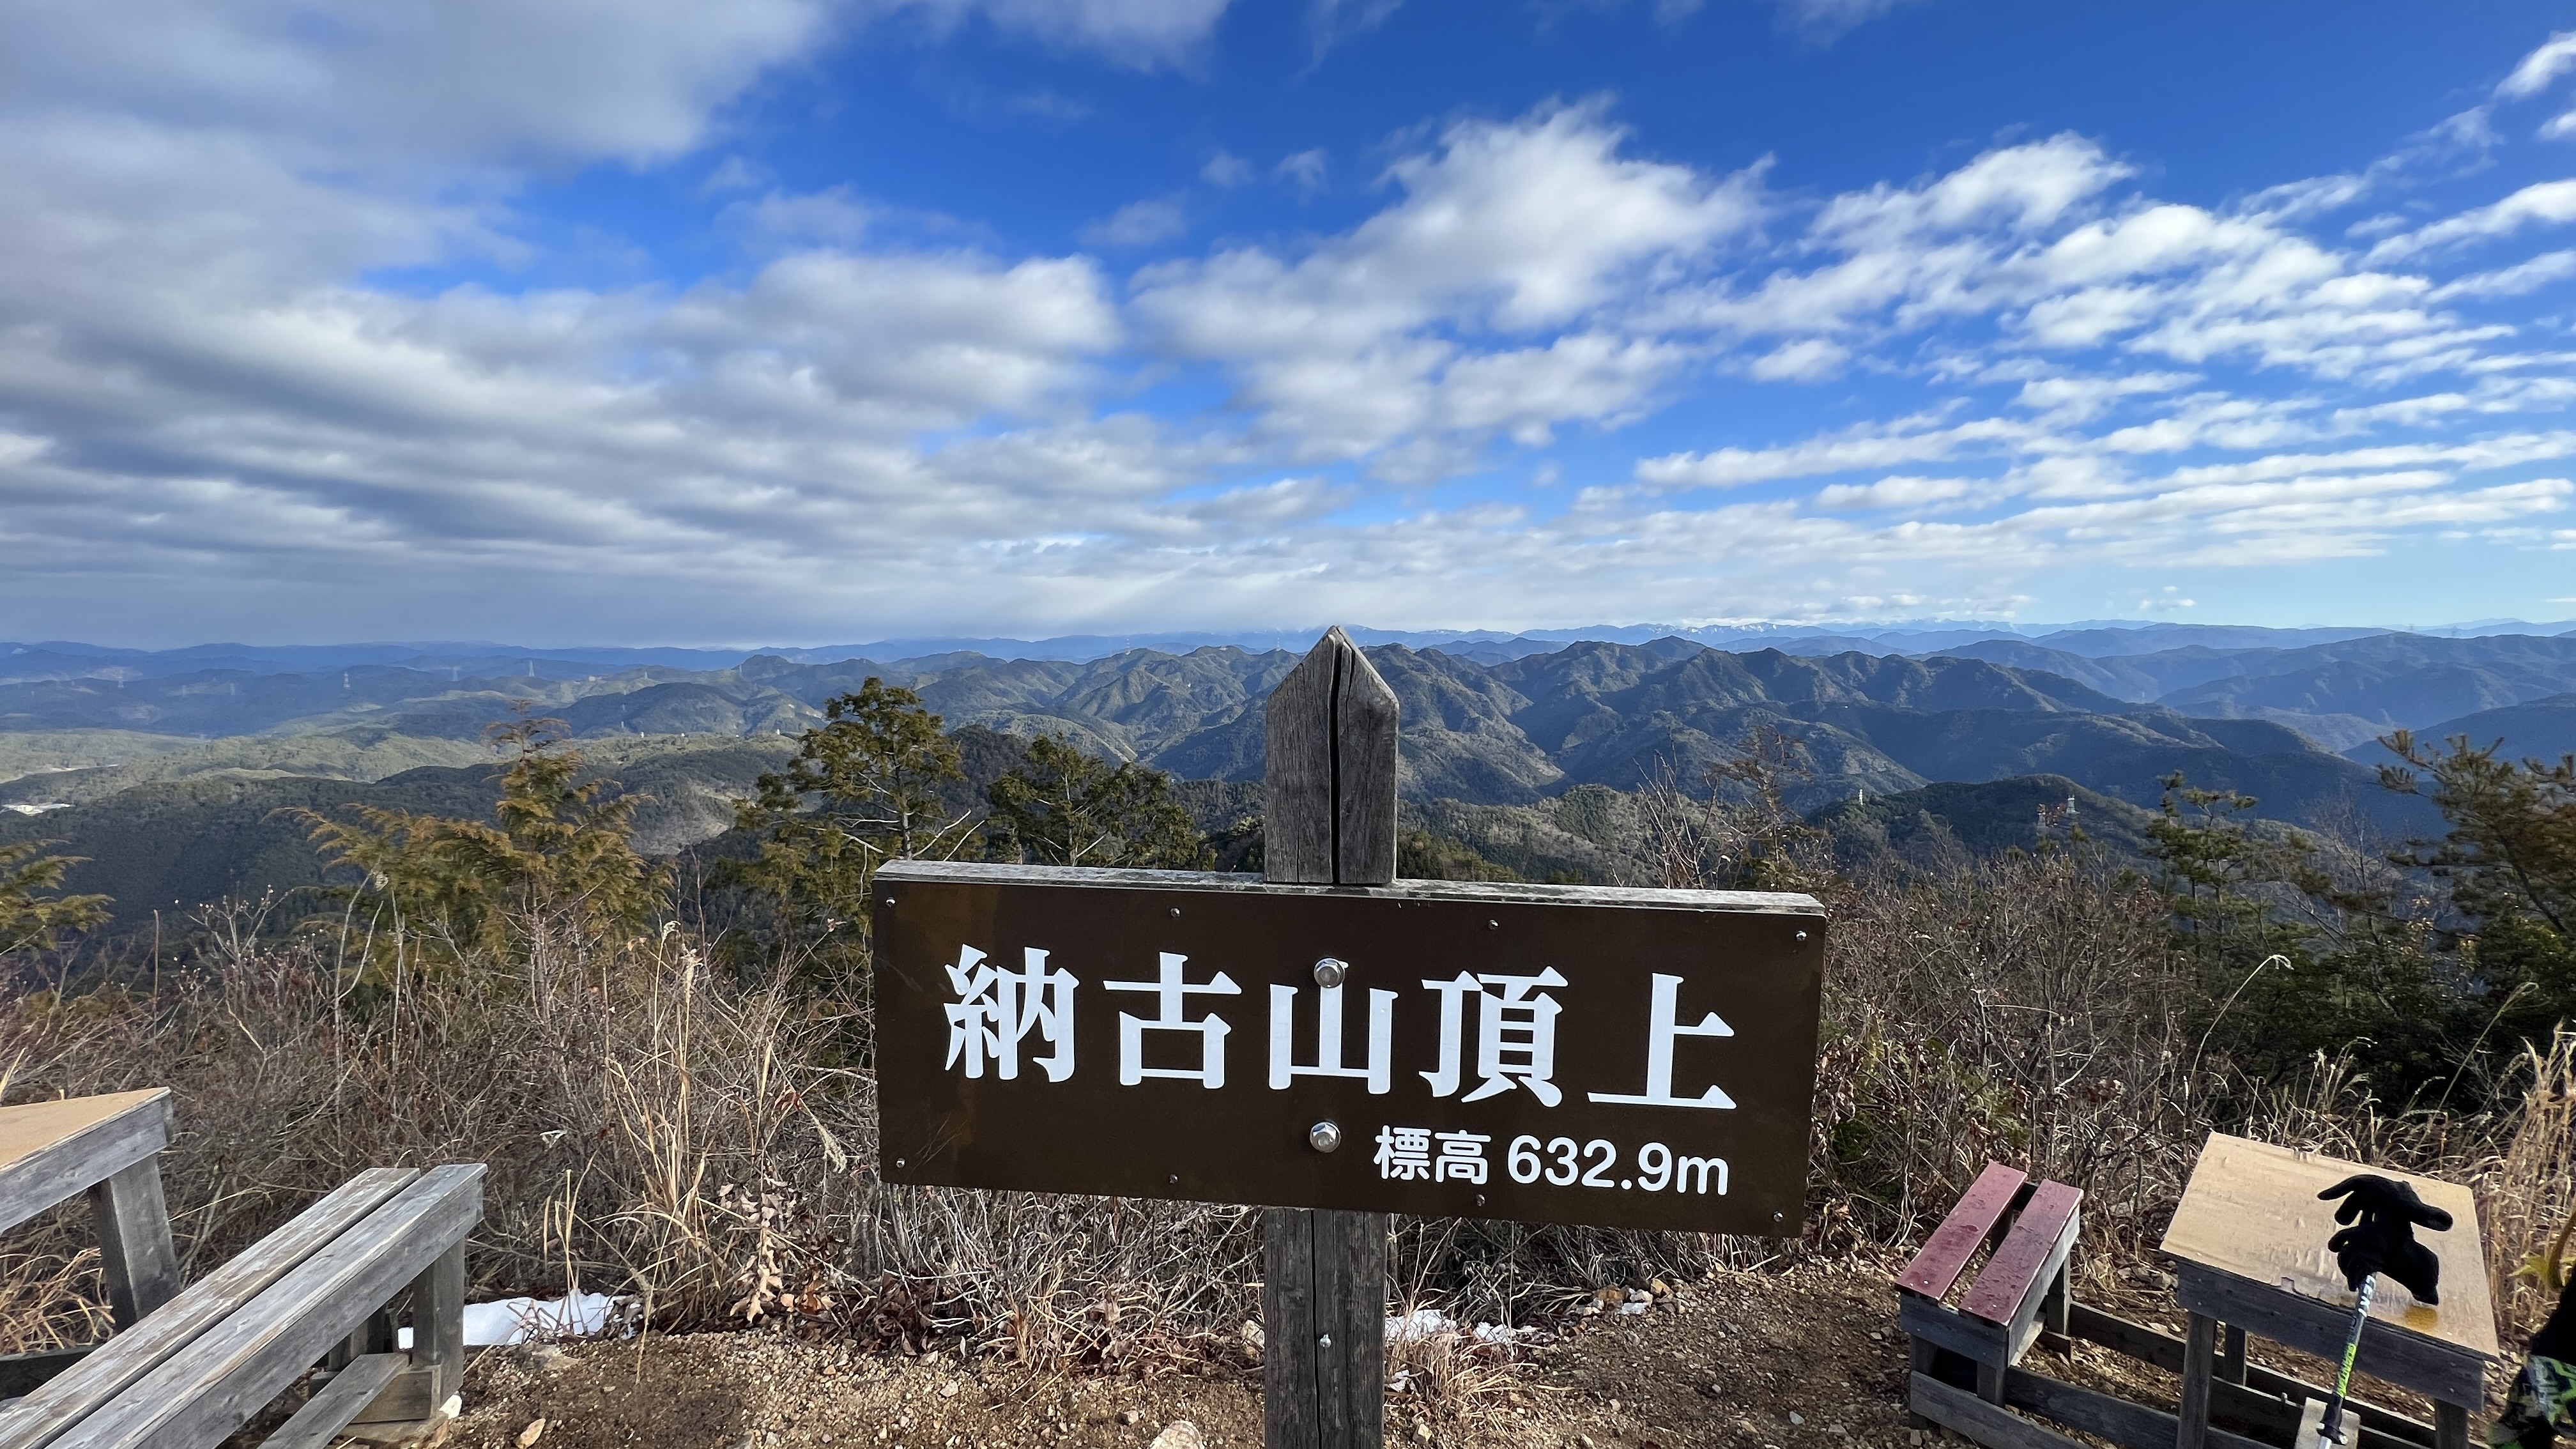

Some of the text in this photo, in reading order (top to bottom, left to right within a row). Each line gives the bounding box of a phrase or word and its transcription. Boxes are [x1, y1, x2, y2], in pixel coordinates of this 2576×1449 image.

[943, 943, 1737, 1110] 納古山頂上
[1374, 1125, 1729, 1195] 標高 632.9m
